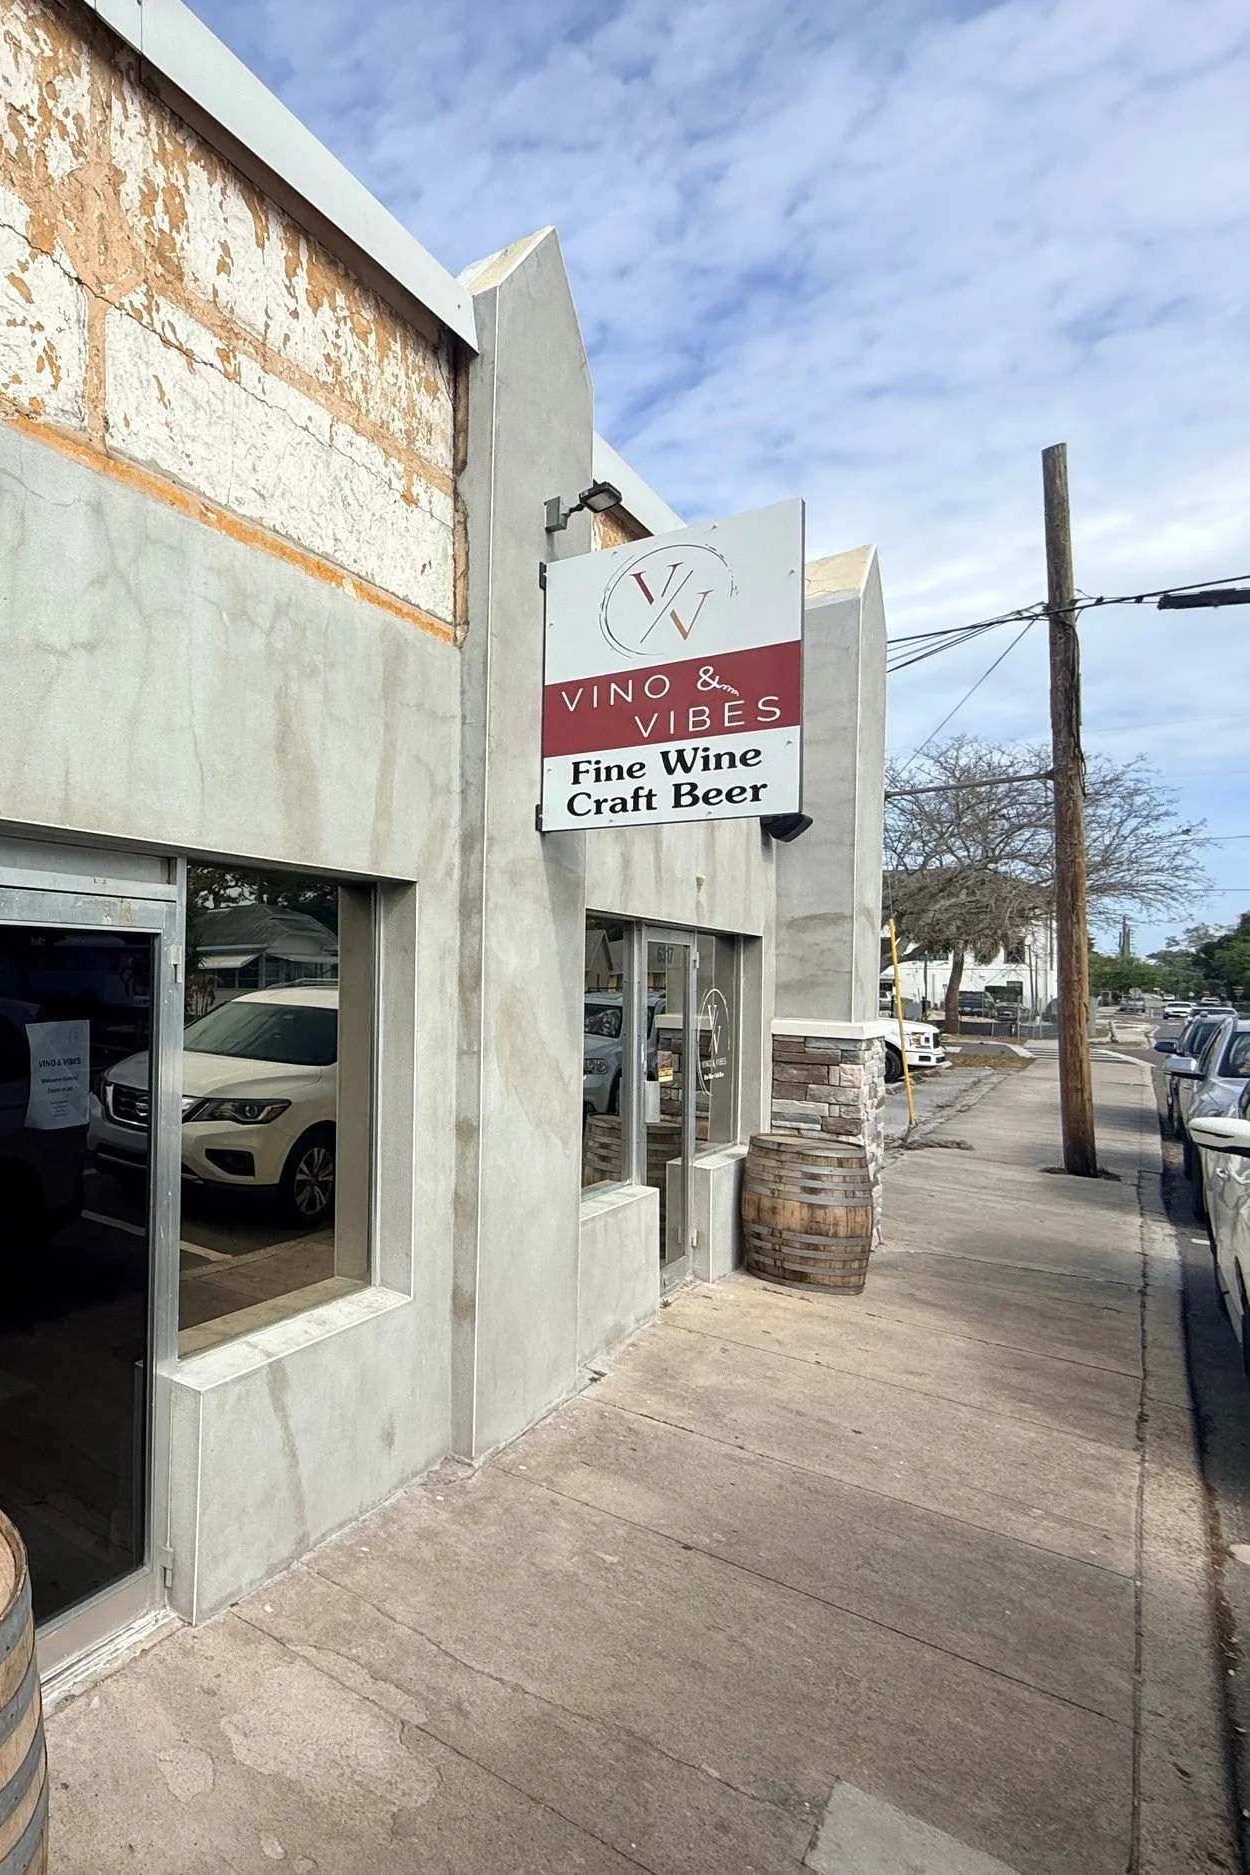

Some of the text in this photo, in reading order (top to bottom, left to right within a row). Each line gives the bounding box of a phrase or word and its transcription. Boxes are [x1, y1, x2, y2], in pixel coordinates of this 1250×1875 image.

[561, 665, 739, 712] VINO &
[634, 696, 781, 738] VIBES
[571, 747, 762, 785] Fine Wine
[566, 781, 768, 817] Craft Beer
